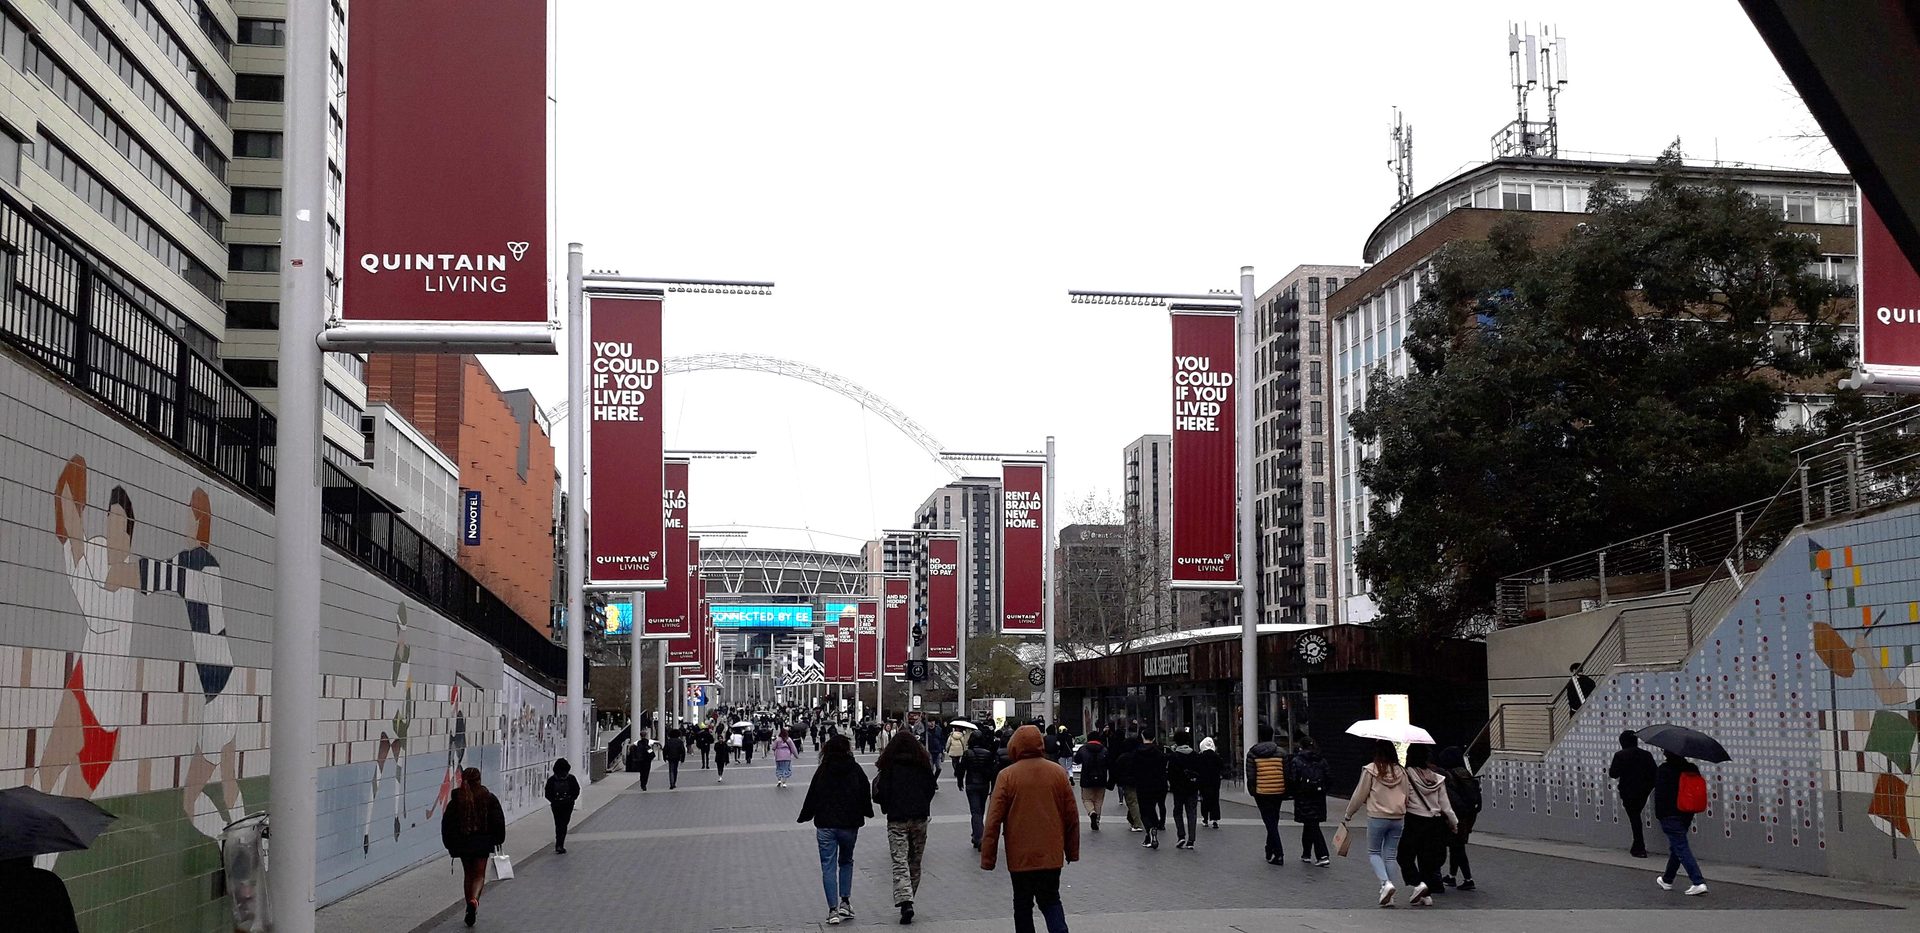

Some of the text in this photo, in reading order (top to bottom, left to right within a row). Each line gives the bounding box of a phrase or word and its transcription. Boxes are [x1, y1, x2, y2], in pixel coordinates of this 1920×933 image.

[360, 253, 506, 273] QUINTAIN
[425, 275, 507, 293] LIVING
[1876, 307, 1920, 325] QUI
[593, 342, 633, 358] YOU
[593, 358, 660, 374] COULD
[1175, 356, 1210, 371] YOU
[593, 374, 653, 390] IF YOU
[1175, 371, 1233, 387] COULD
[594, 389, 645, 405] LIVED
[1175, 386, 1227, 402] IF YOU
[594, 405, 644, 421] HERE.
[1176, 401, 1220, 416] LIVED
[1176, 416, 1219, 431] HERE.
[677, 489, 686, 499] A
[1005, 491, 1041, 501] RENT A
[664, 499, 687, 509] AND
[1005, 500, 1041, 510] BRAND
[468, 494, 478, 539] NOVOTEL
[1005, 509, 1029, 519] NEW
[665, 518, 684, 528] ME.
[1005, 518, 1039, 528] HOME.
[596, 556, 650, 564] QUINTAIN
[619, 563, 650, 571] LIVING
[1177, 557, 1224, 565] QUINTAIN
[712, 611, 809, 622] CONNECTED BY EE
[1299, 634, 1327, 664] BLACK SHEEP COFFEE
[1144, 653, 1188, 677] BLACK SHEEP COFFEE
